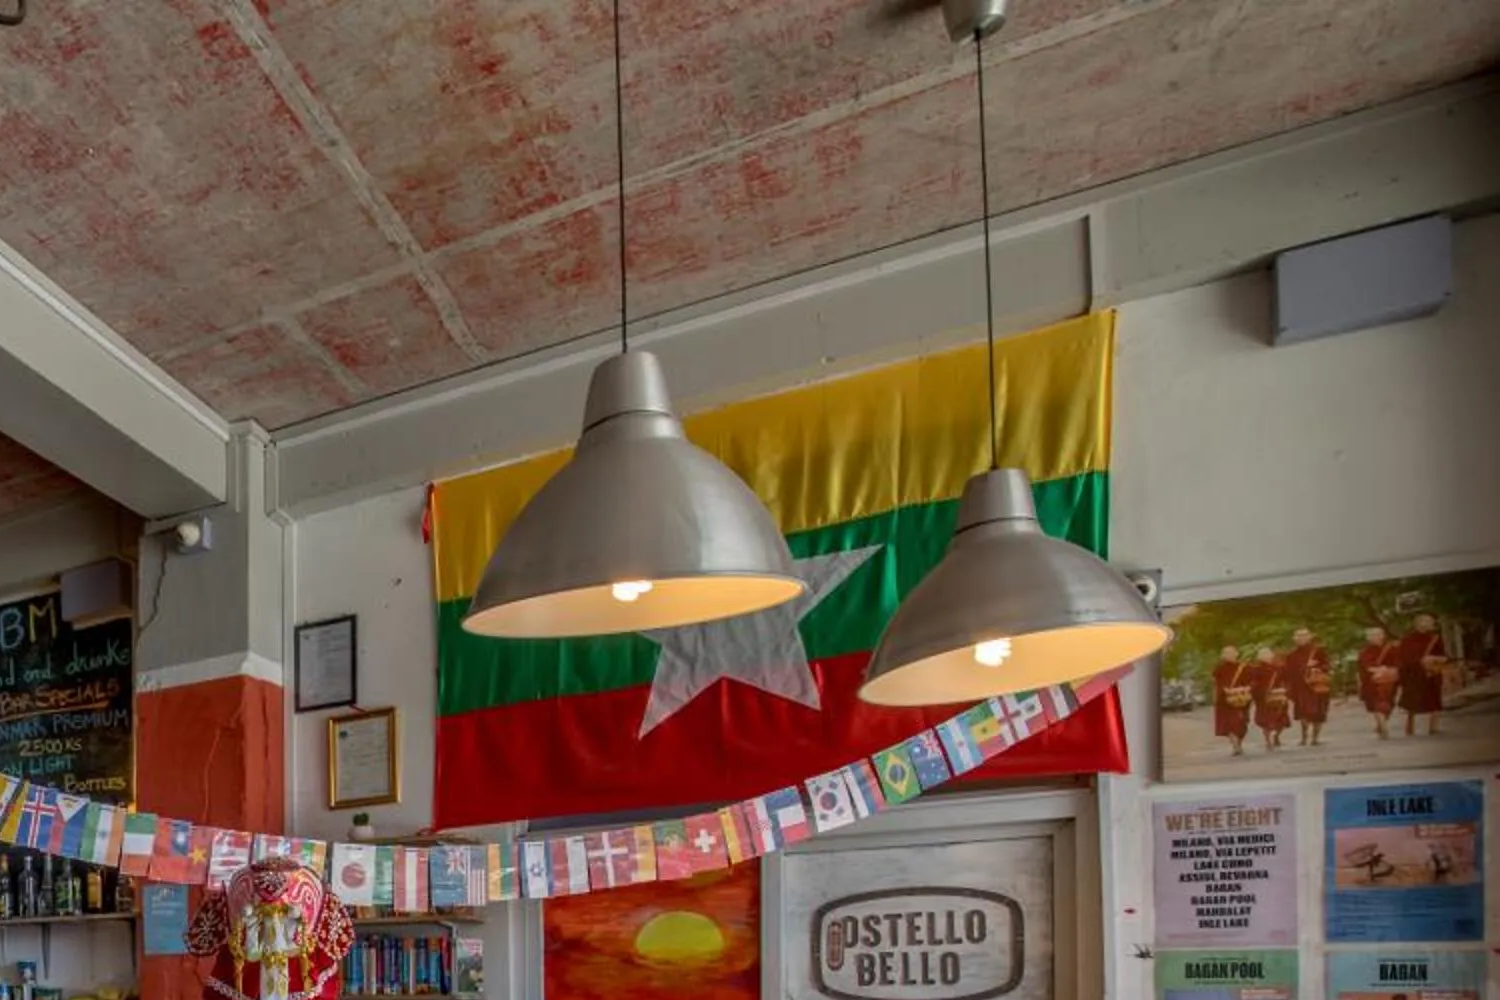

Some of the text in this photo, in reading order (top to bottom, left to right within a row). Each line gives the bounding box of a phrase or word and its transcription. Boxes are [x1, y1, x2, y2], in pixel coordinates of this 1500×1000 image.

[23, 651, 55, 683] and
[52, 708, 129, 735] PREMIUM
[17, 737, 62, 757] 2500
[29, 754, 75, 775] LIGHT
[1226, 807, 1283, 827] EIGHT
[842, 909, 987, 949] OSTELLO
[856, 951, 961, 987] BELLO
